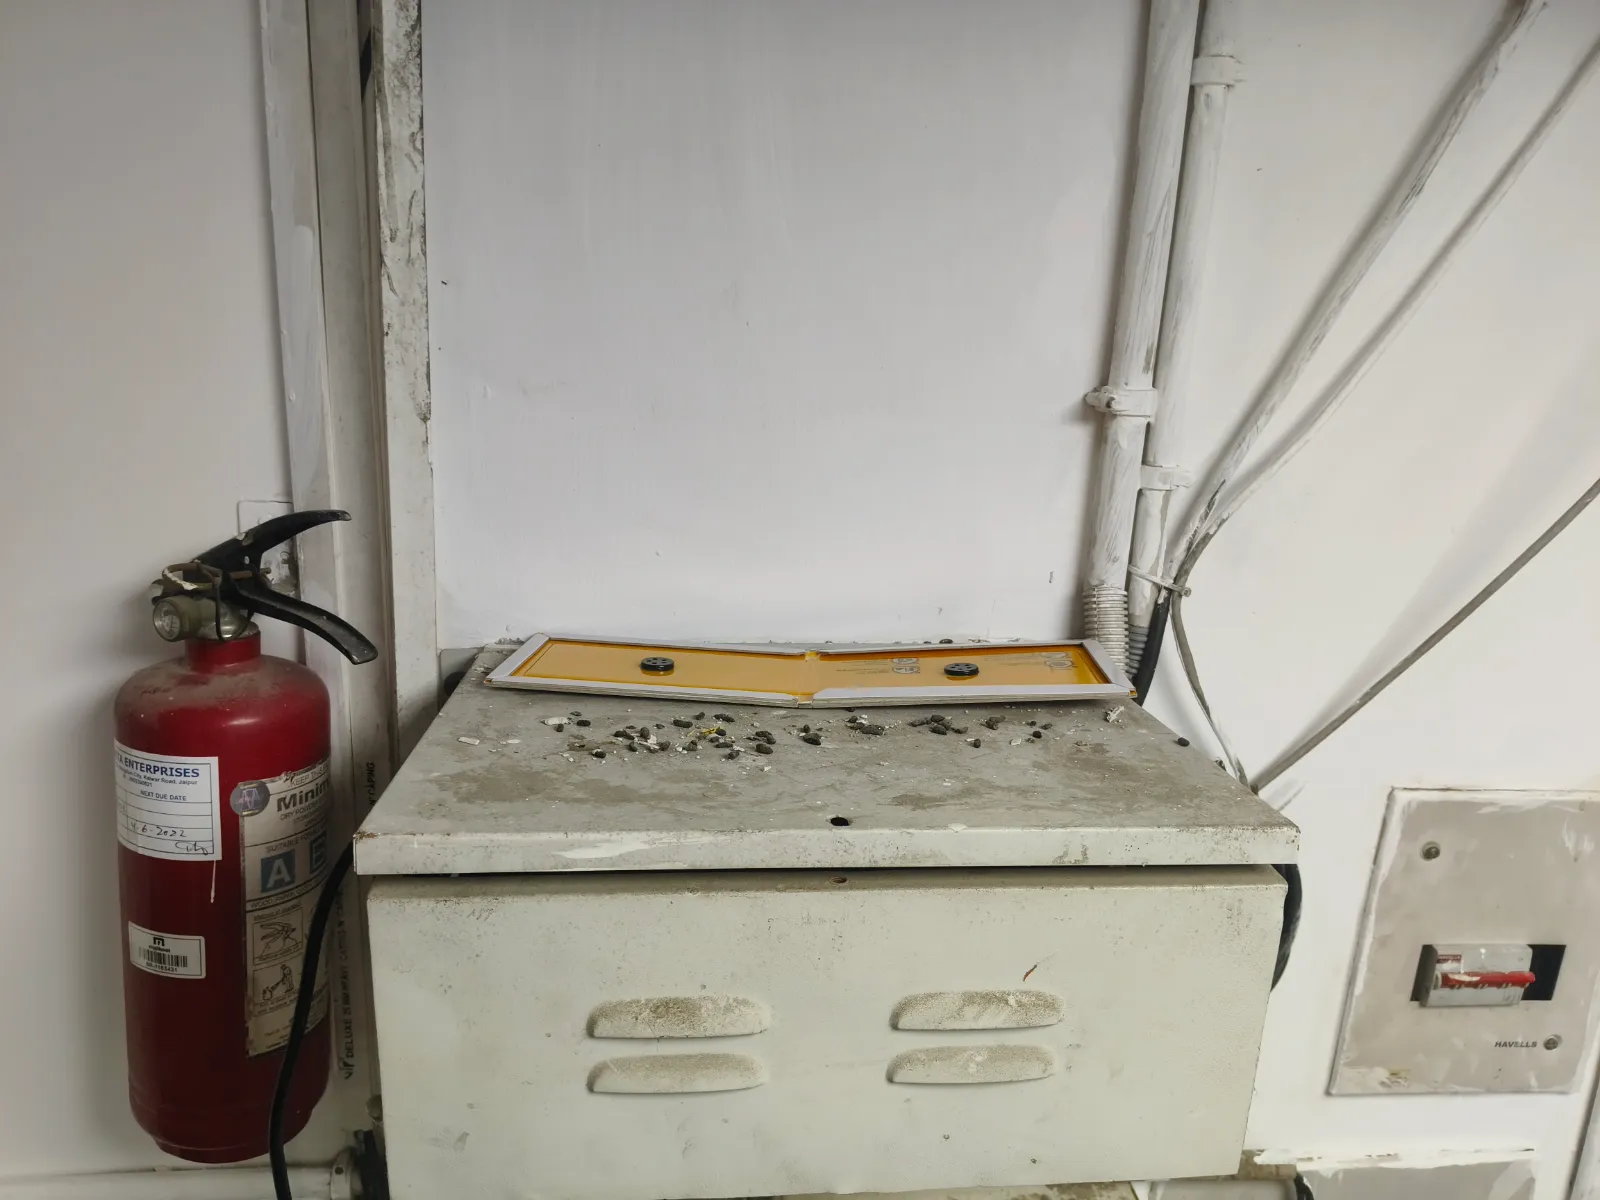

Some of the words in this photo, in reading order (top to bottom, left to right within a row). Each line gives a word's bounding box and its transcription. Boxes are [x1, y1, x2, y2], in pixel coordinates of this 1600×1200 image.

[124, 757, 200, 778] ENTERPRISES
[140, 789, 154, 798] NEXT
[155, 792, 168, 800] DUE
[265, 858, 292, 889] A
[343, 1019, 355, 1058] DELUXE
[1494, 1040, 1538, 1048] HAVELLS
